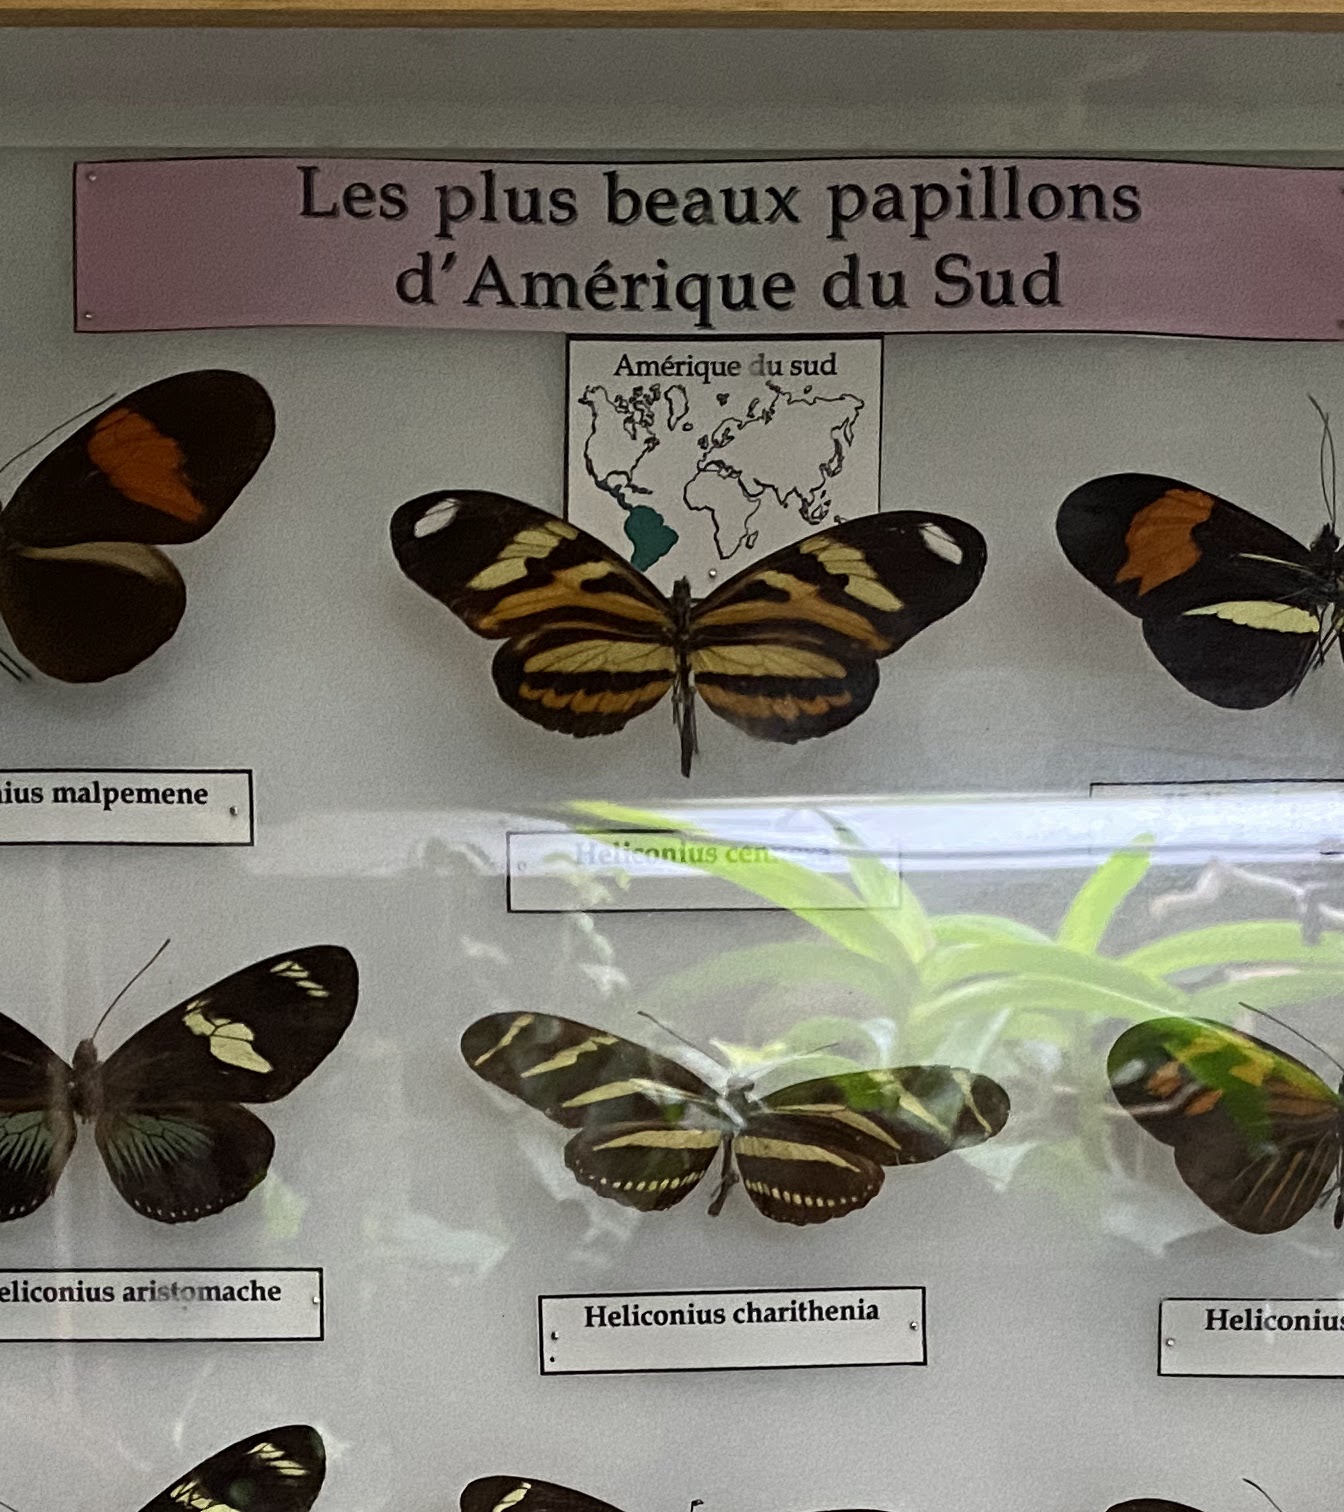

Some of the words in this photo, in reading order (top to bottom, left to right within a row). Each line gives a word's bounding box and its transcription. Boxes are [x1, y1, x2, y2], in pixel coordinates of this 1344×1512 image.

[296, 165, 409, 220] Les
[434, 168, 578, 239] plus
[602, 170, 801, 226] beaux
[825, 165, 1143, 240] papillons
[395, 250, 797, 329] d'Amérique
[822, 252, 910, 309] du
[933, 250, 1065, 308] Sud
[612, 352, 743, 385] Amérique
[747, 352, 784, 377] du
[789, 351, 838, 377] sud
[51, 781, 209, 812] malpemene
[121, 1279, 282, 1304] aristomache
[583, 1302, 726, 1328] Heliconius
[732, 1297, 880, 1324] charithenia
